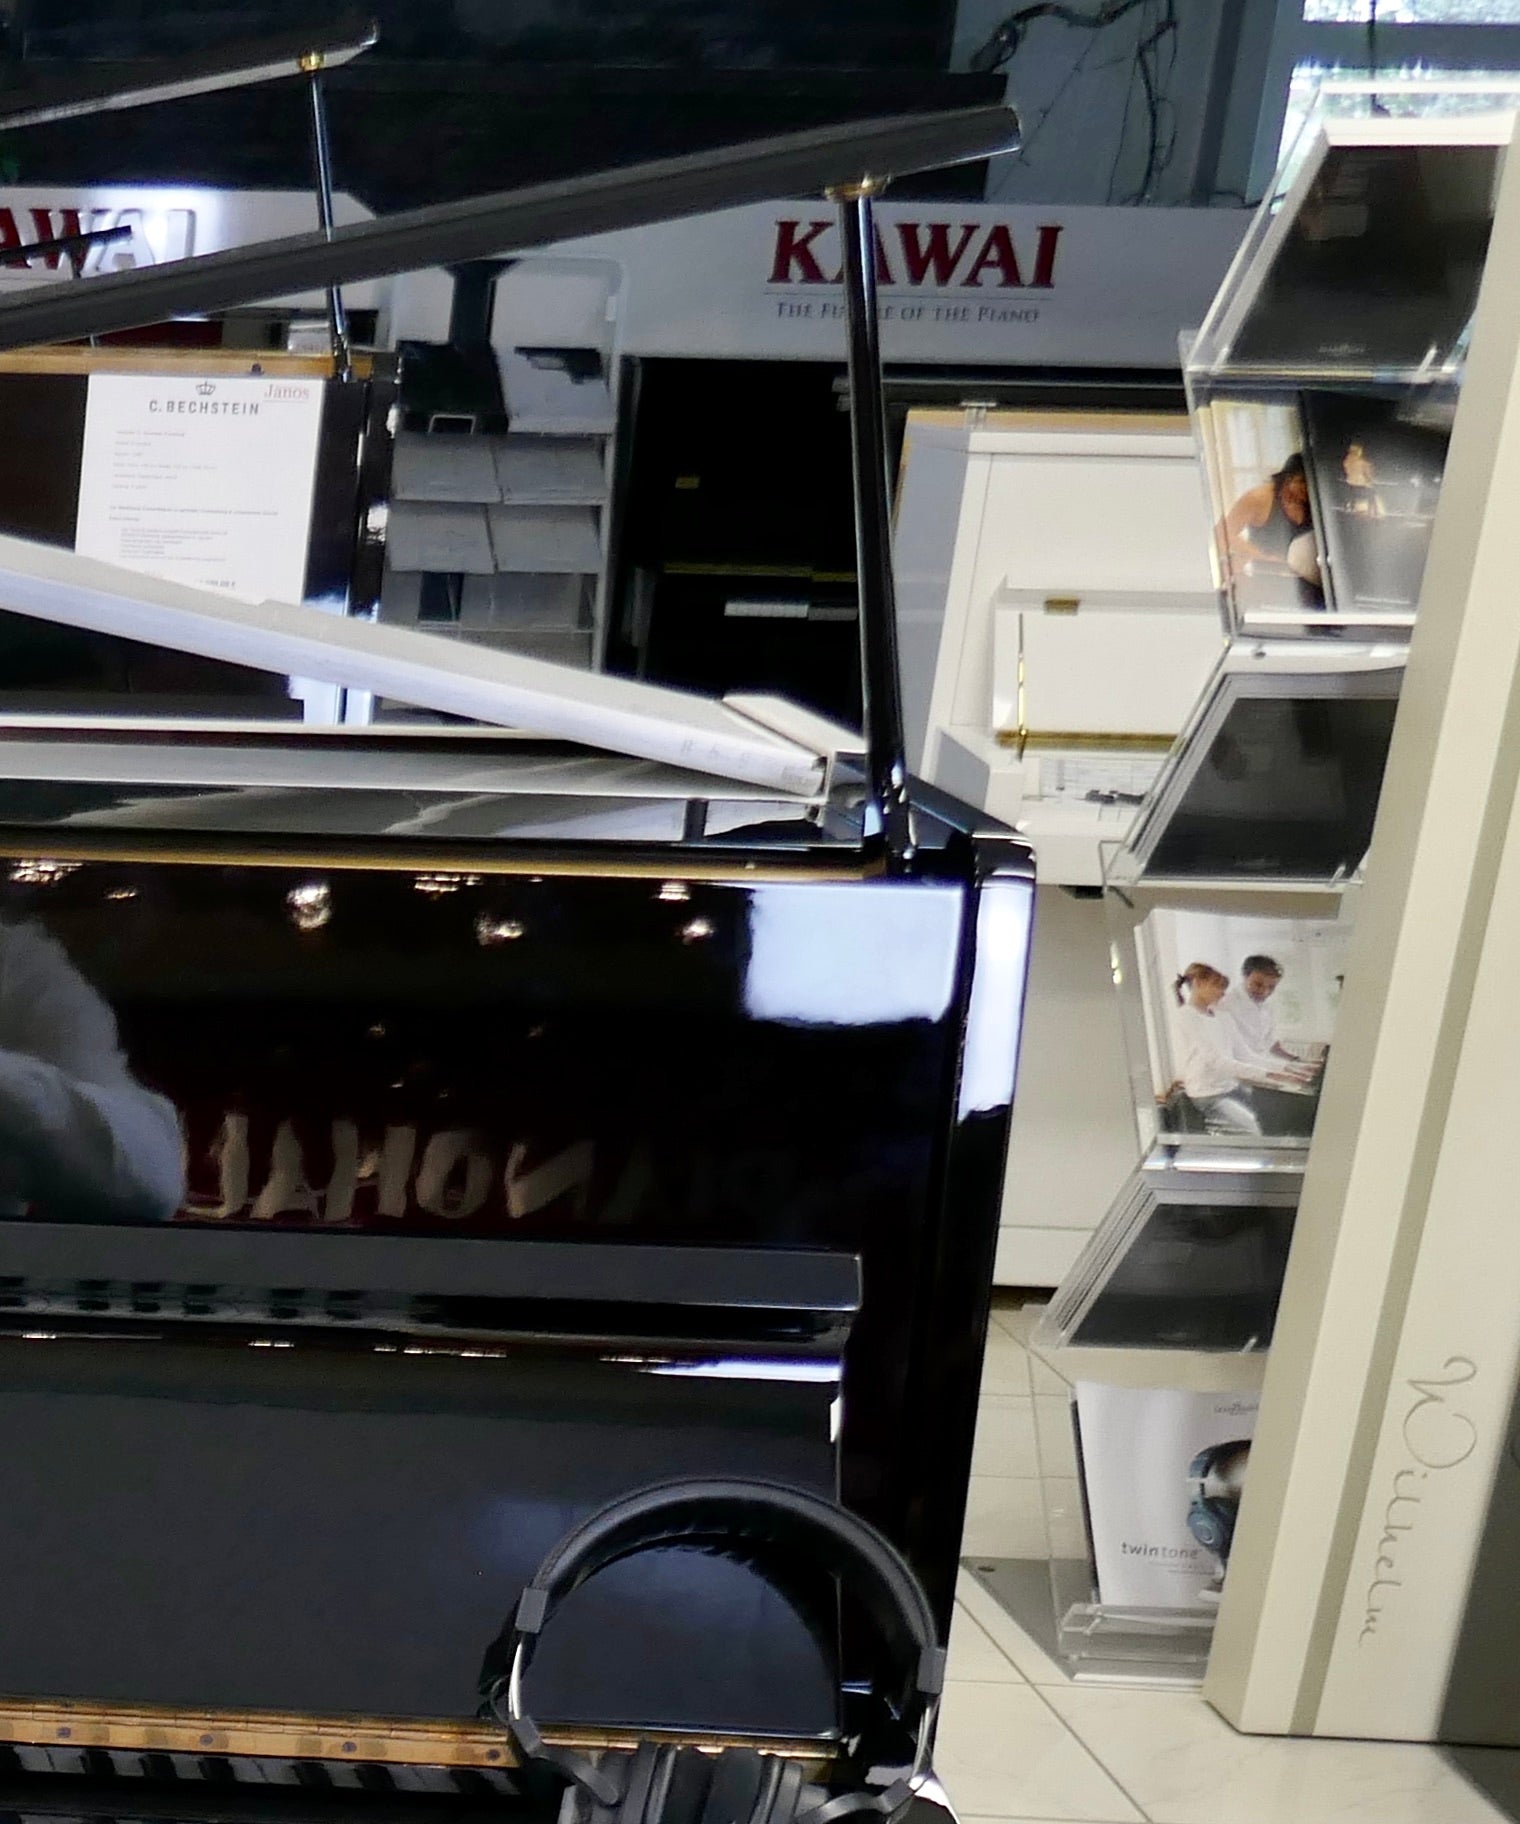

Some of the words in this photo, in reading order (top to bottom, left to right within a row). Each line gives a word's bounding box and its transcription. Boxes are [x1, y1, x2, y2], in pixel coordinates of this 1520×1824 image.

[263, 383, 311, 400] Janos
[148, 400, 162, 413] C.
[166, 401, 260, 416] BECHSTEIN
